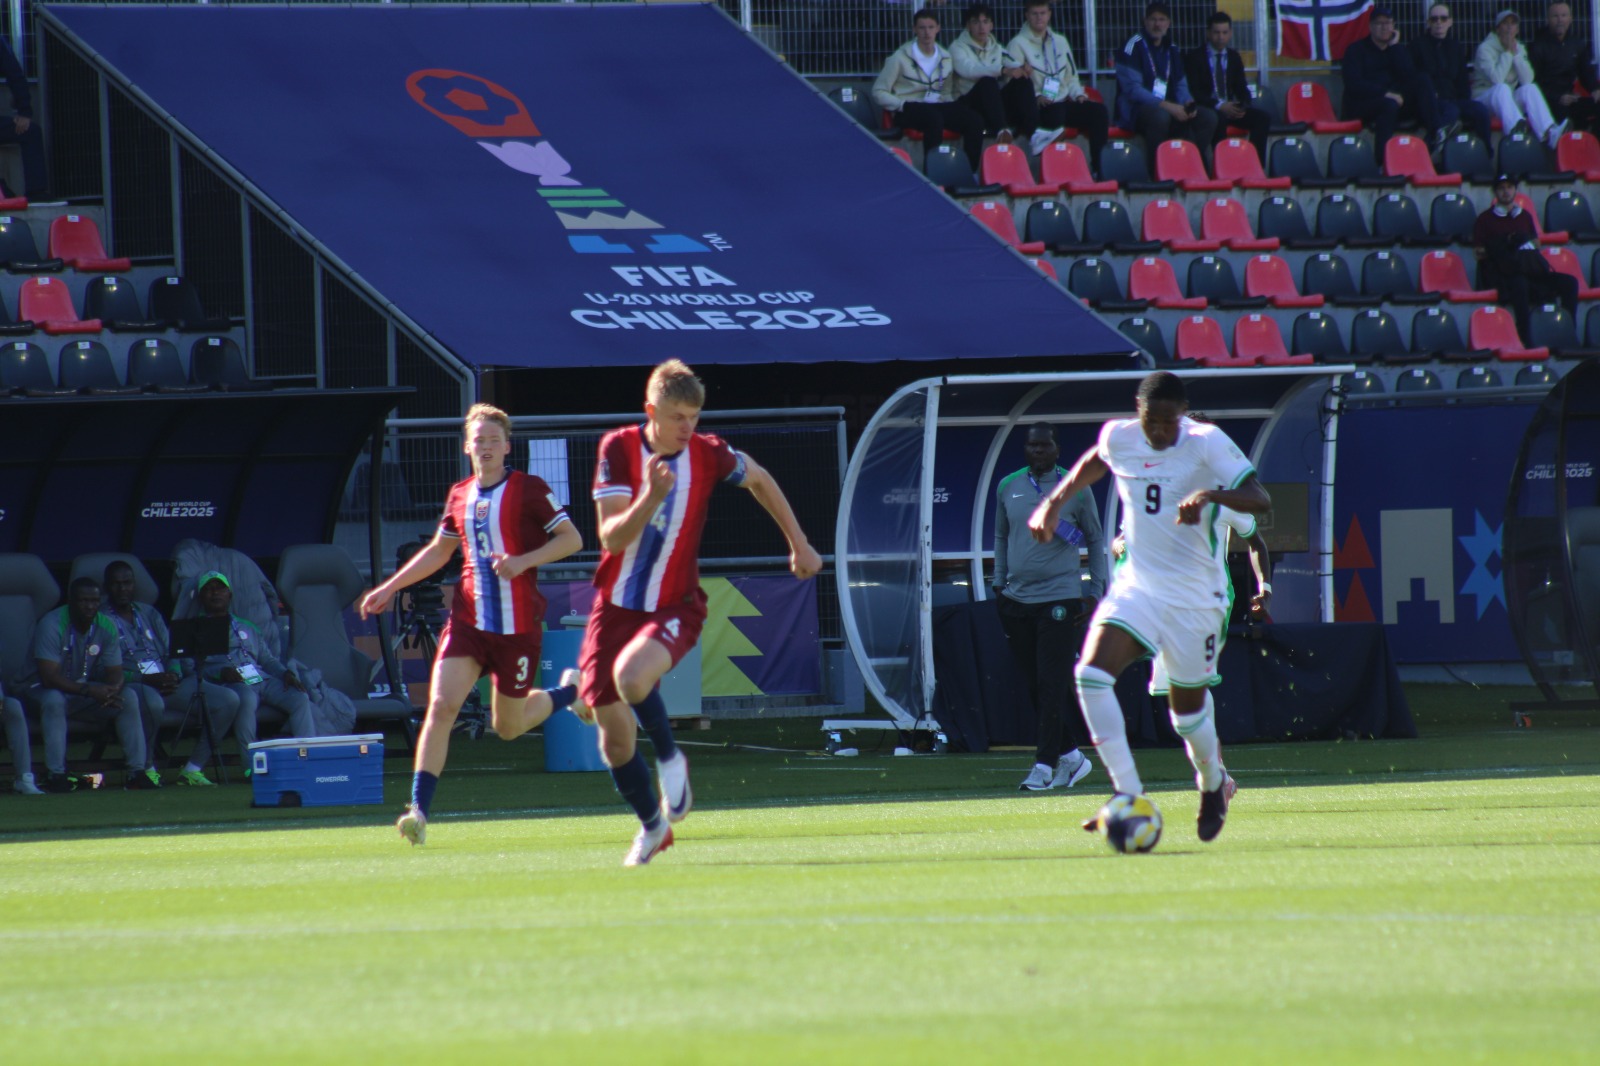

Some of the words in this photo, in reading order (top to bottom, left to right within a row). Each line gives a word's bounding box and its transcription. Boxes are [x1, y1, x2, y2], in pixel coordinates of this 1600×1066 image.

[611, 266, 737, 286] FIFA
[583, 293, 651, 305] U-20
[650, 293, 757, 305] WORLD
[758, 291, 815, 304] CUP
[1145, 484, 1161, 515] 9
[650, 501, 667, 532] 4
[477, 532, 489, 558] 3
[665, 618, 680, 638] 4
[1205, 633, 1216, 662] 9
[516, 656, 529, 681] 3
[315, 775, 349, 783] POWERADE
